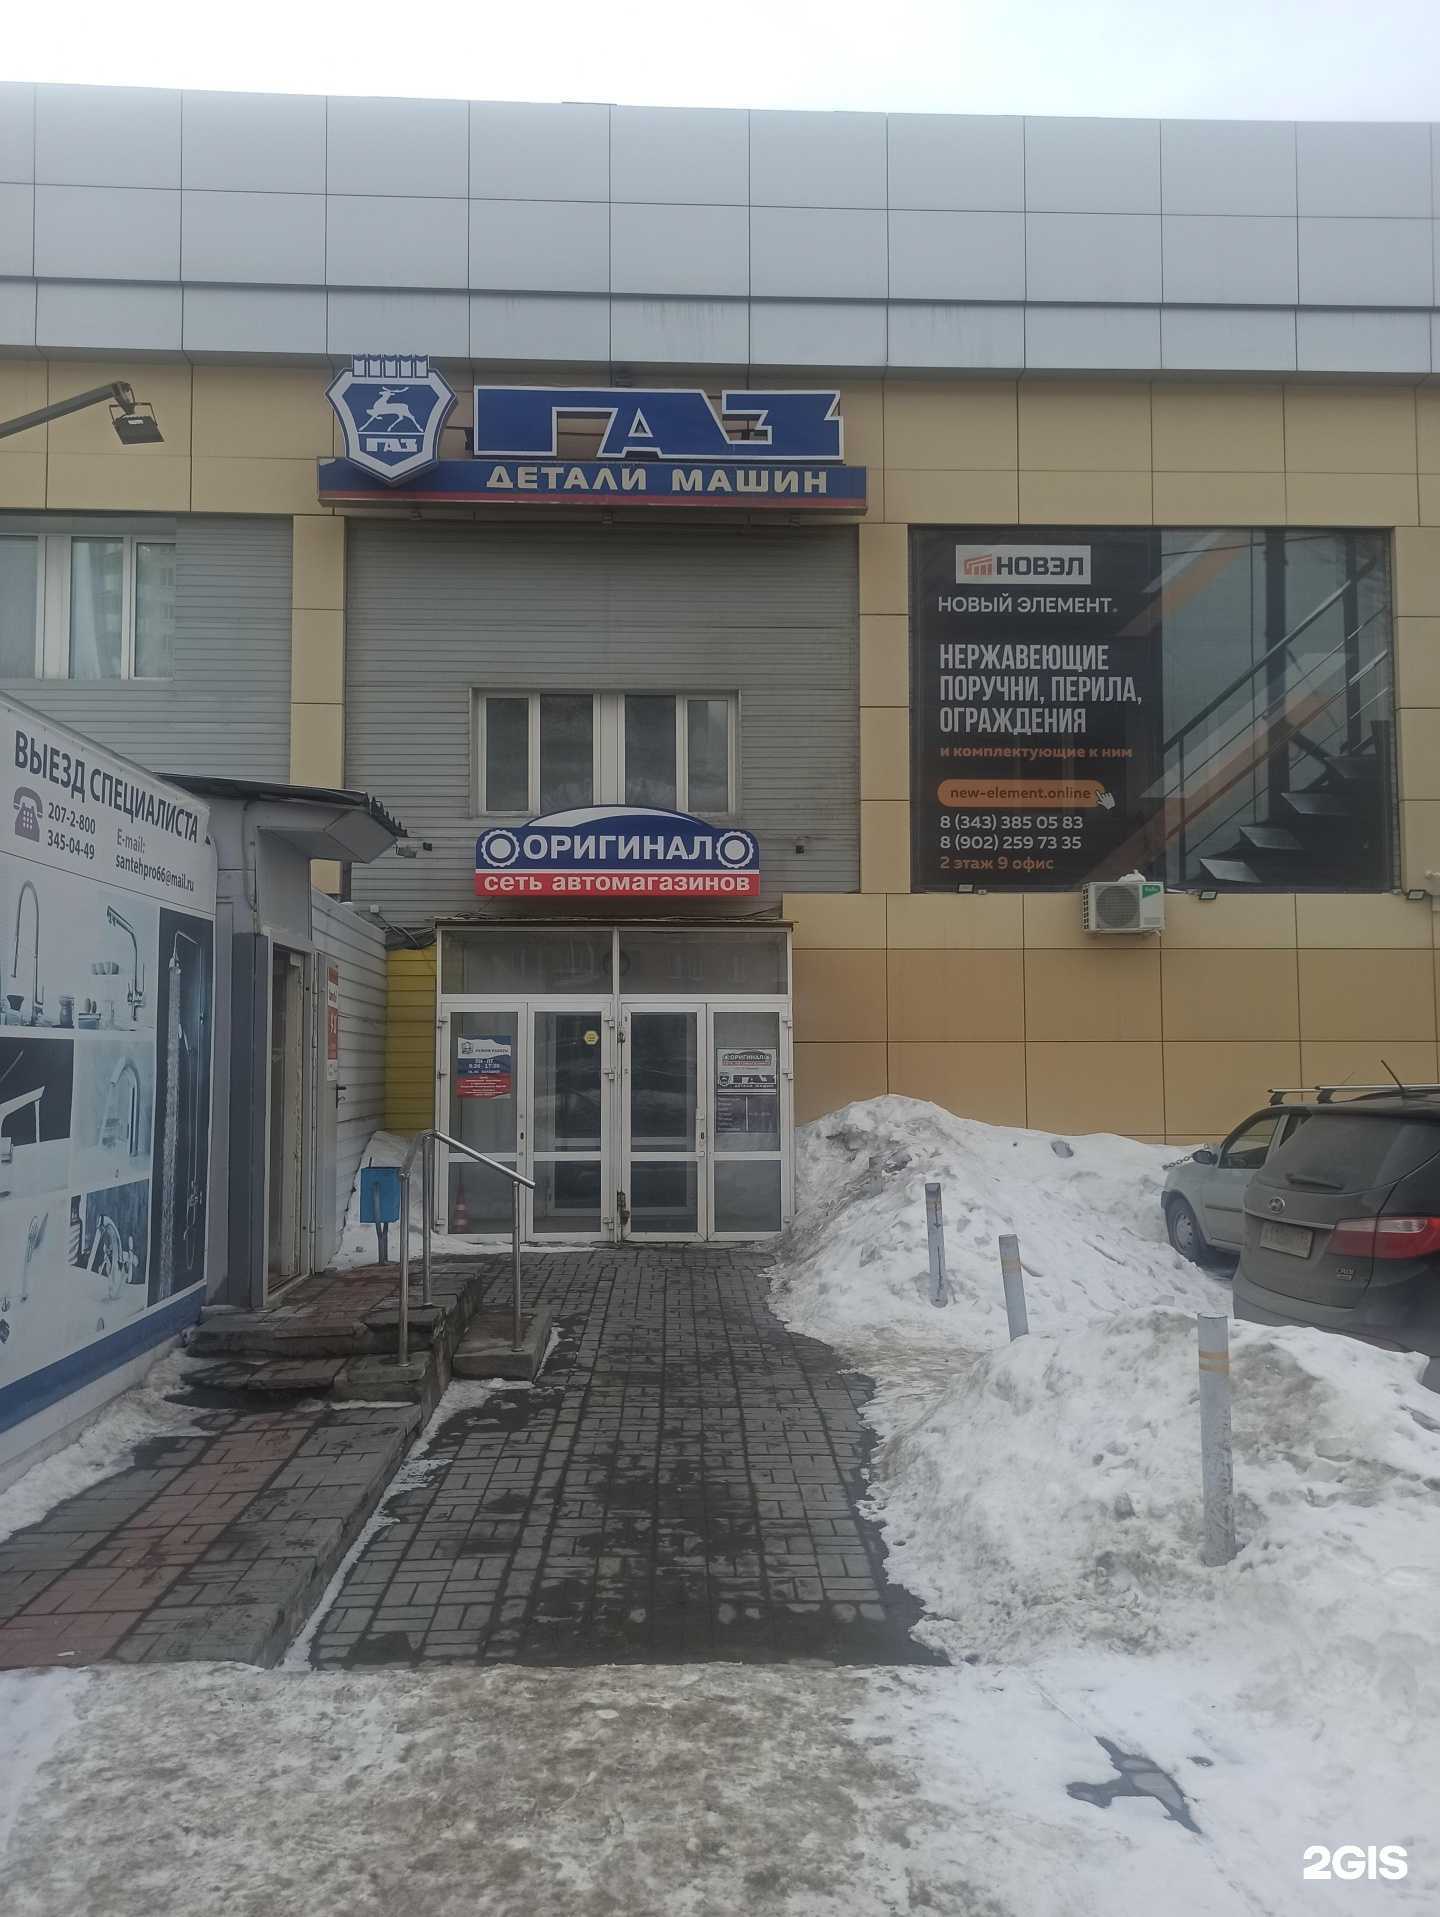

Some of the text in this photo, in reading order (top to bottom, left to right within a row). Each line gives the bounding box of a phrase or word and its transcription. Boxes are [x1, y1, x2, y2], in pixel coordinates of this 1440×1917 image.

[474, 385, 844, 460] ГАЗ
[366, 438, 418, 452] ГАЗ
[486, 465, 828, 494] ДЕТАЛИ МАШИН
[996, 556, 1084, 577] НОВЭЛ
[938, 593, 1012, 613] НОВЫЙ
[939, 643, 1110, 672] НЕРЖАВЕЮЩИЕ
[939, 675, 1142, 704] ПОРУЧНИ, ПЕРИЛА,
[939, 707, 1087, 735] ОГРАЖДЕНИЯ
[940, 747, 1133, 761] и комплектующие к ним
[15, 730, 198, 844] ВЫЕЗД СПЕЦИАЛИСТА
[950, 786, 1092, 800] new-element.online
[48, 802, 96, 835] 207-2-800
[940, 814, 1083, 831] 8 (343) 385 05 83
[47, 829, 95, 860] 345-04-49
[116, 828, 146, 854] E-mail:
[523, 834, 713, 860] ОРИГИНАЛ
[940, 834, 1082, 851] 8 (902) 259 73 35
[115, 854, 194, 892] santehpro66@mail.ru
[940, 857, 1054, 872] 2 этаж 9 офис
[484, 876, 750, 891] сеть автомагазинов
